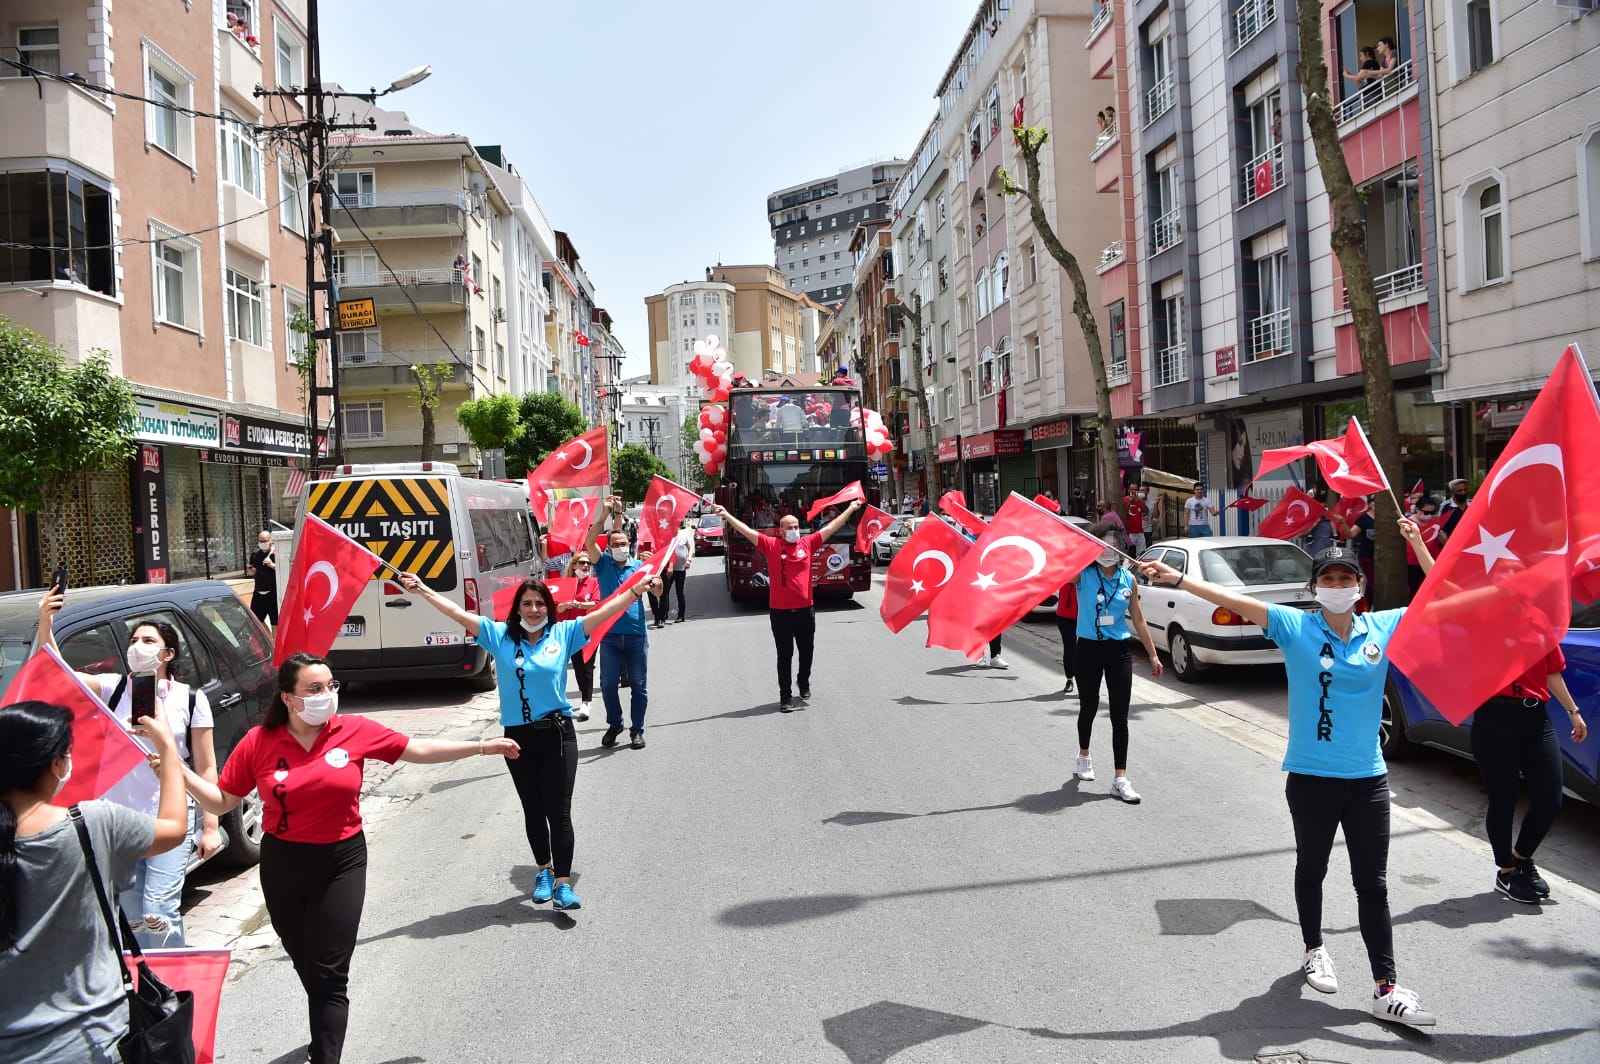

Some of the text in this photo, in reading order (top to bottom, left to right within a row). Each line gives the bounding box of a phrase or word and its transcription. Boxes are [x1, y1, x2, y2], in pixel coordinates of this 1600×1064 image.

[341, 309, 372, 319] DURAĞI
[171, 417, 217, 441] TÜTÜNCÜSÜ
[247, 425, 275, 445] EVDORA
[274, 429, 295, 448] PERDE
[1033, 421, 1069, 440] BERBER
[214, 453, 240, 464] EVDORA
[244, 455, 263, 465] PERDE
[148, 481, 161, 561] PERDE
[379, 519, 434, 540] TAŞITI
[435, 636, 451, 645] 153
